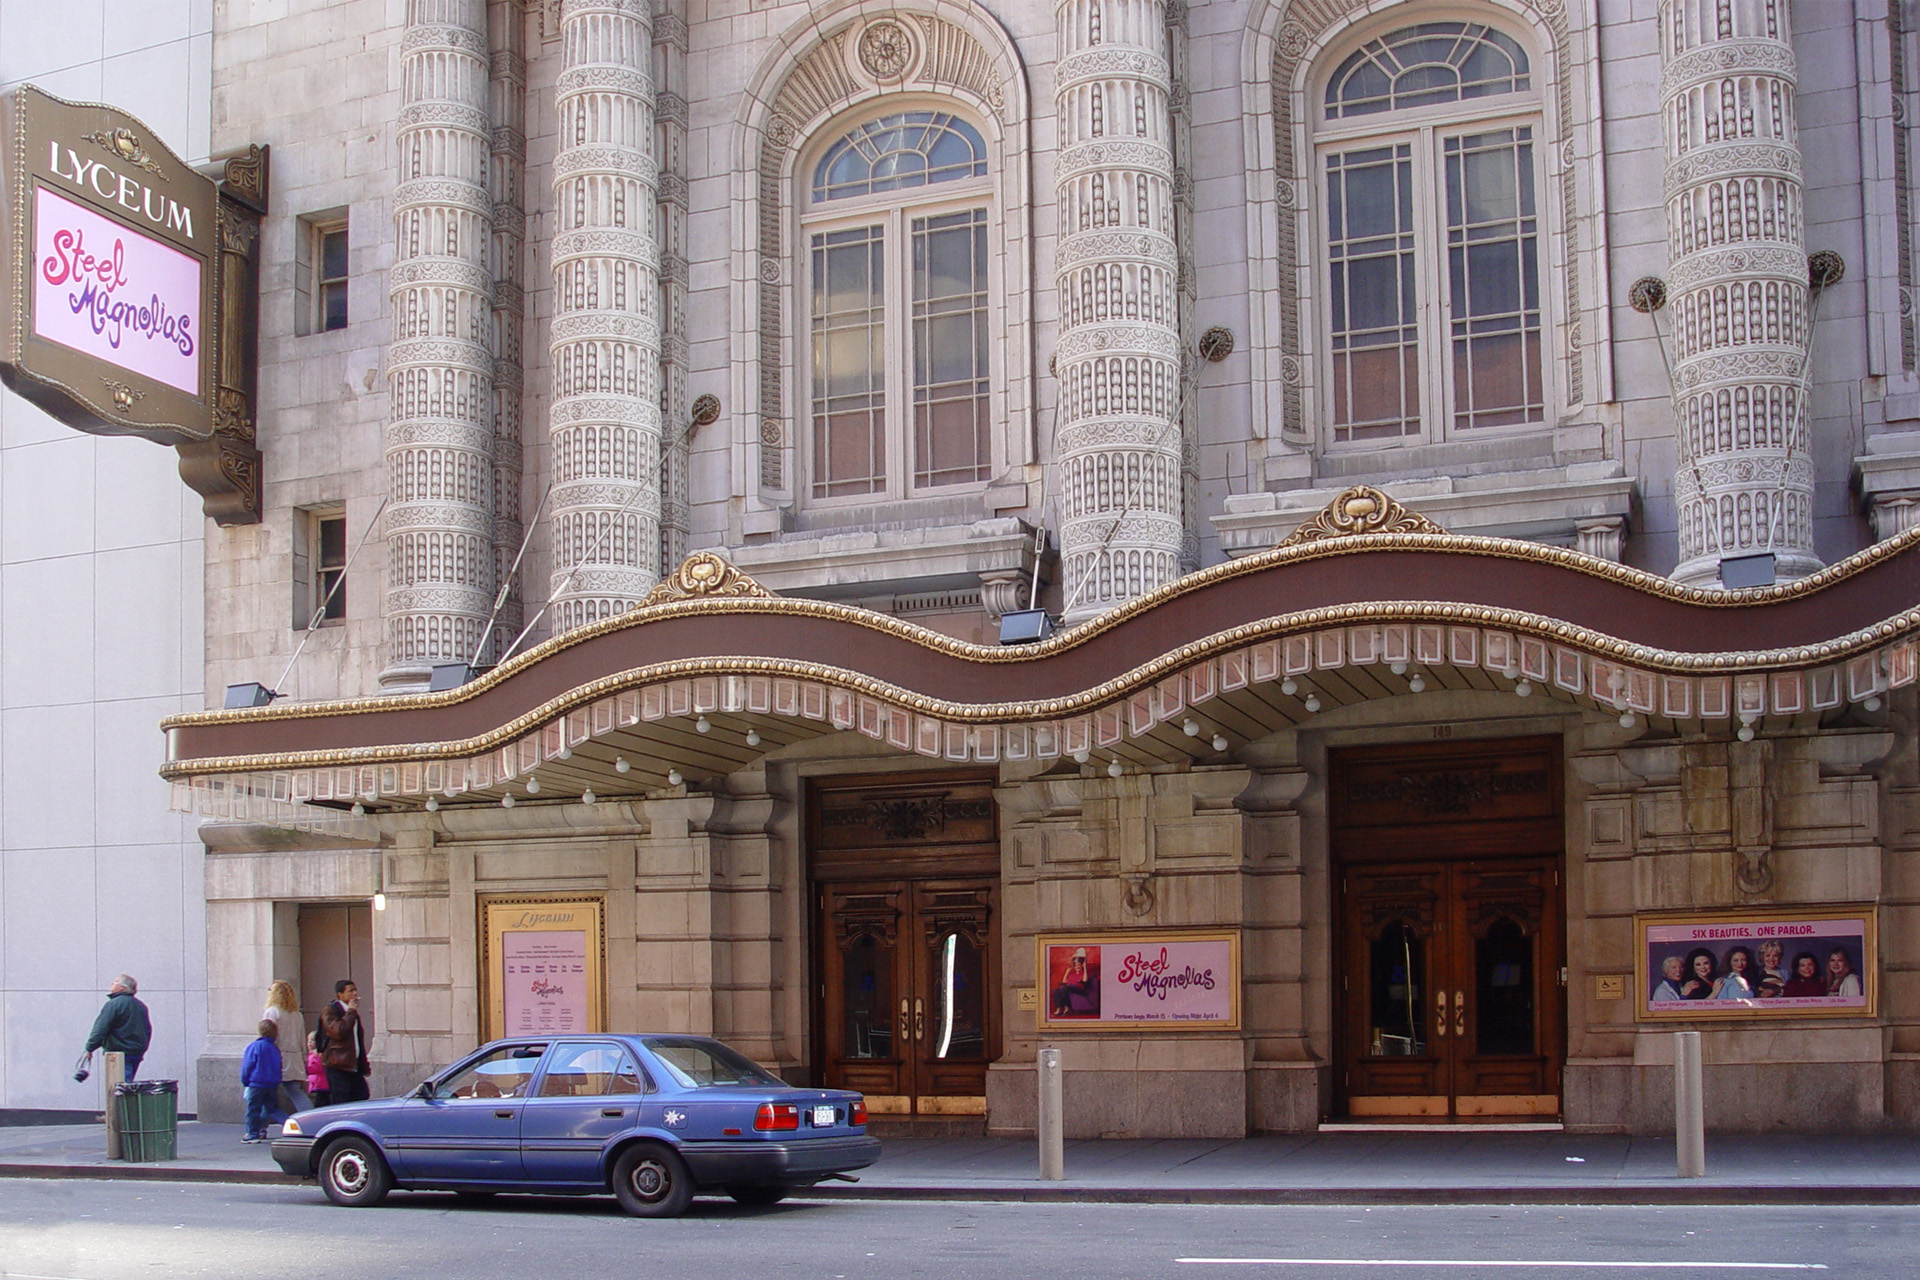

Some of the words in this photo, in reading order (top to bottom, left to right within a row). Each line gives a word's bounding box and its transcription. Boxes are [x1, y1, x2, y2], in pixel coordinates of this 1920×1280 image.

[50, 141, 194, 239] LYCEUM
[43, 229, 127, 292] Steel
[69, 277, 194, 357] Magnolias
[1433, 725, 1451, 737] 149
[512, 911, 574, 928] Lyceum
[1692, 929, 1707, 939] SIX
[1709, 926, 1753, 939] BEAUTIES.
[1757, 926, 1776, 937] ONE
[1778, 924, 1816, 936] PARLOR.
[1118, 946, 1170, 983] Steel
[1134, 965, 1216, 1001] Magnolias
